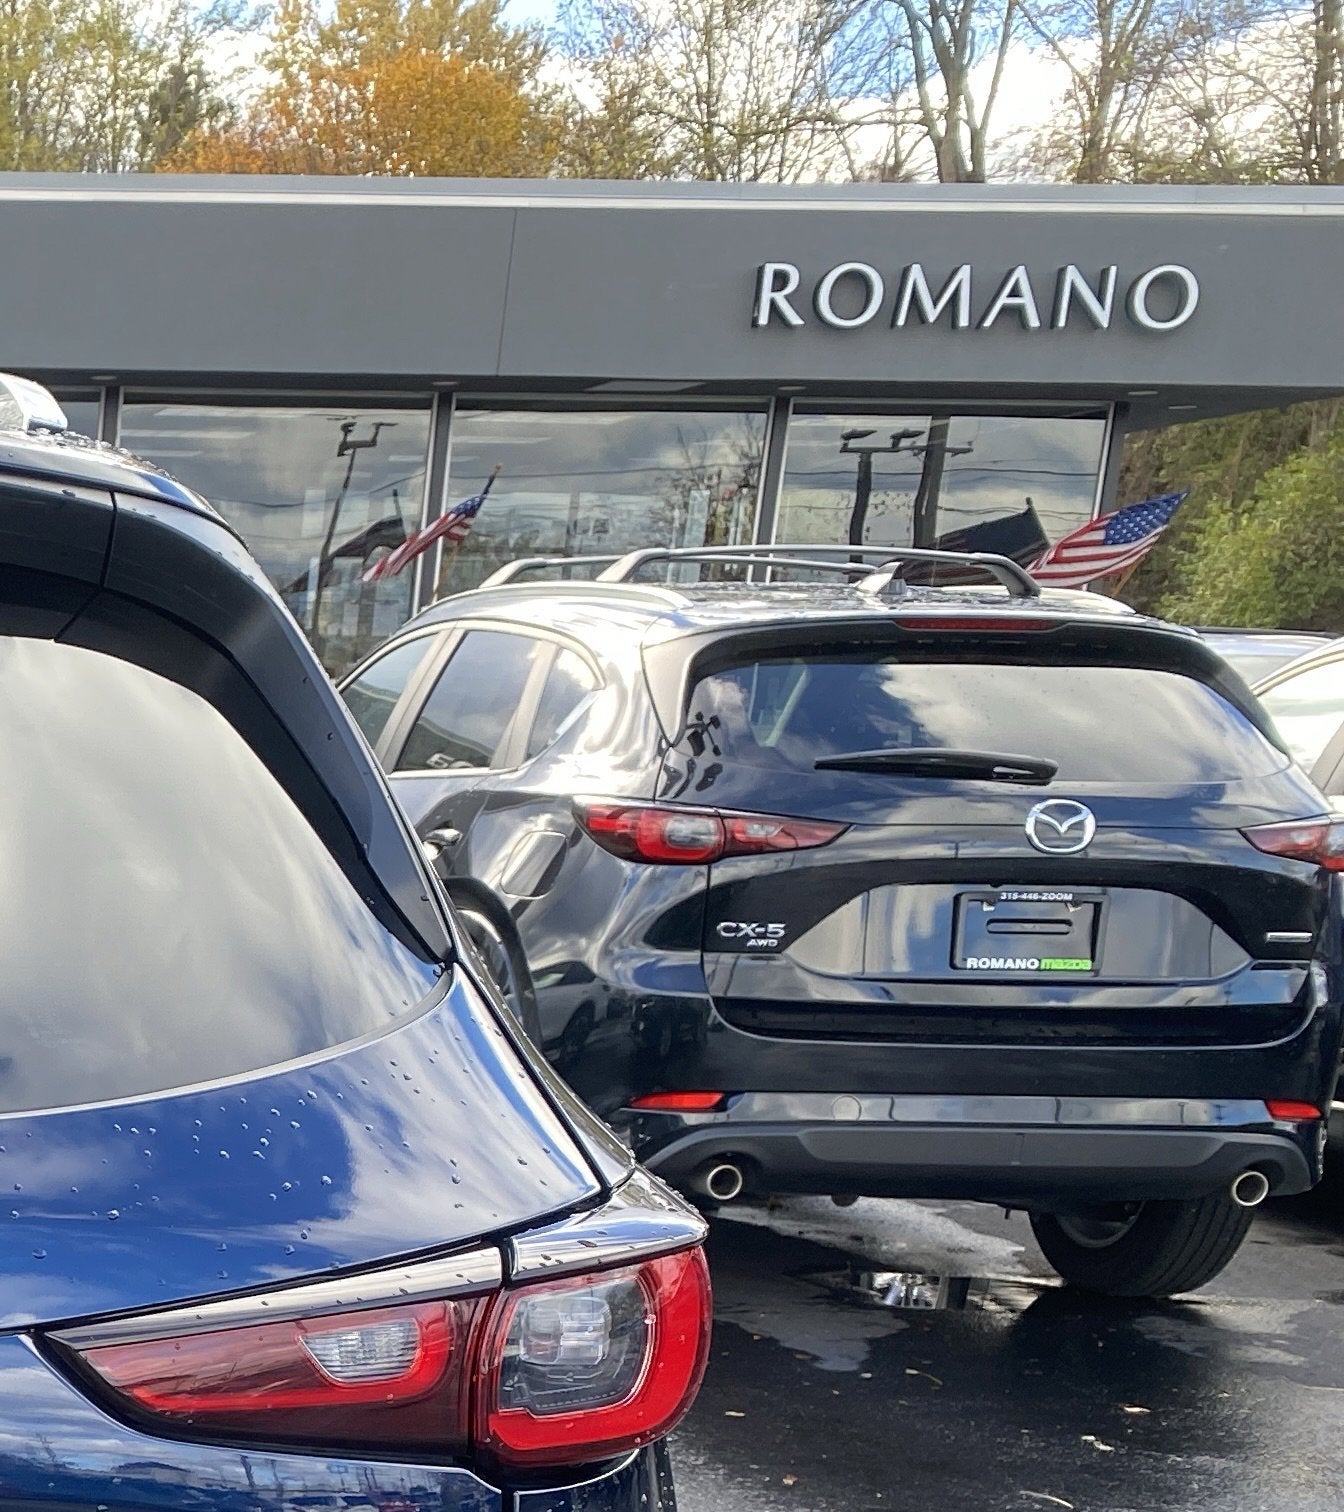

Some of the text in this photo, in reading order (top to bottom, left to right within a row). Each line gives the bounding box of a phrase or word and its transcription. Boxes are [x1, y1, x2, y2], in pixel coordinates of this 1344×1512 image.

[752, 261, 1200, 330] ROMANO
[717, 921, 786, 938] CX-5
[746, 939, 778, 947] AWD
[966, 957, 1039, 969] ROMANO
